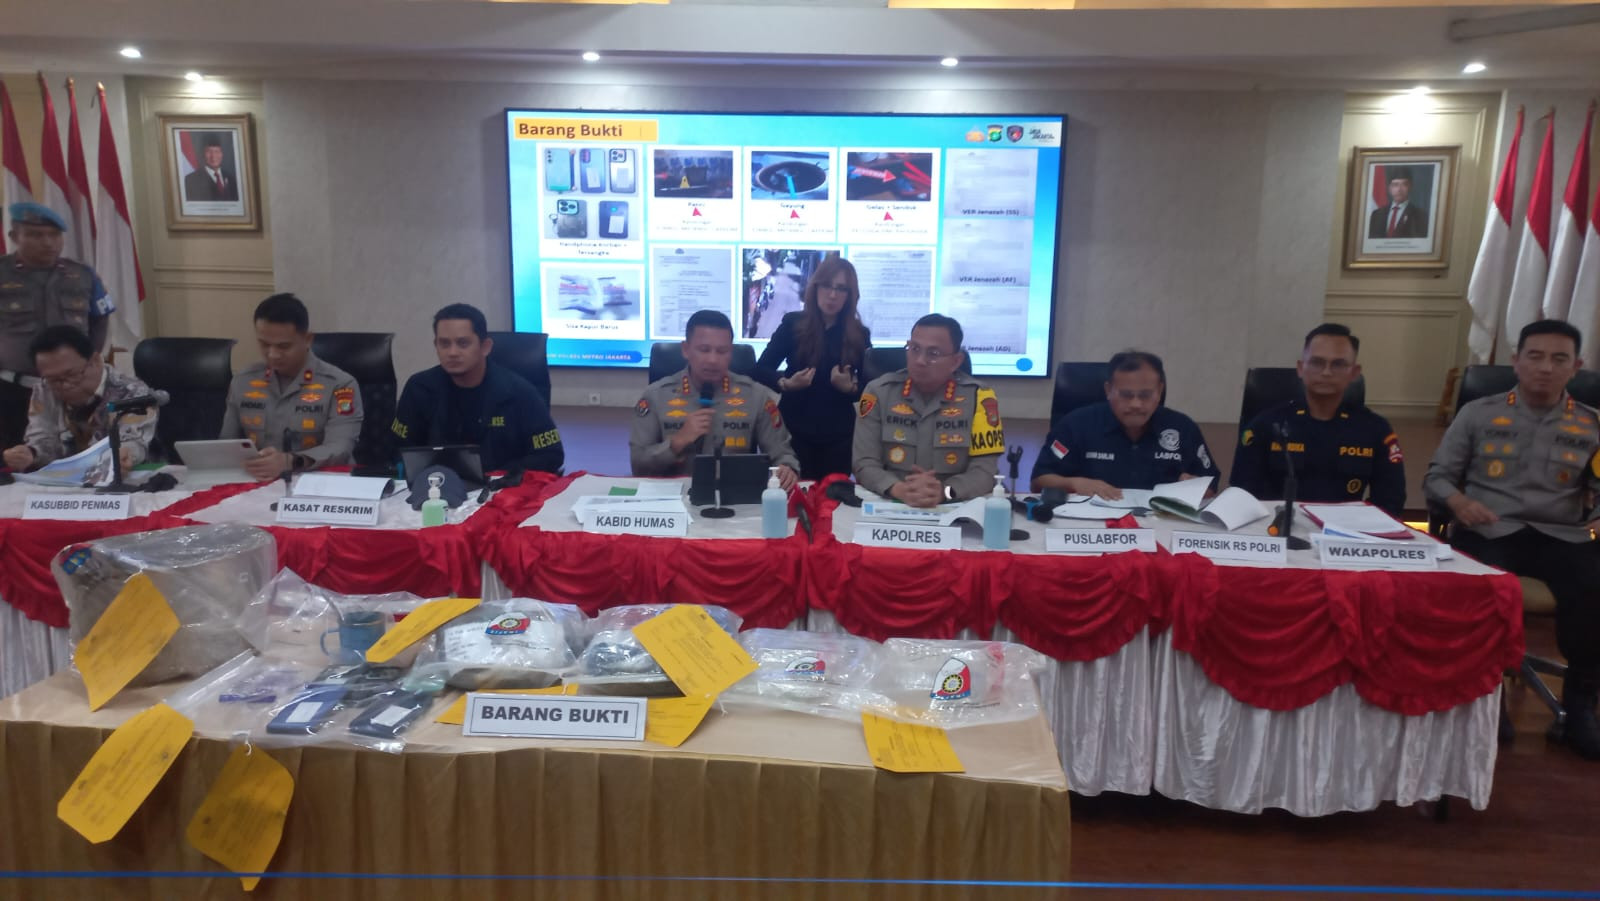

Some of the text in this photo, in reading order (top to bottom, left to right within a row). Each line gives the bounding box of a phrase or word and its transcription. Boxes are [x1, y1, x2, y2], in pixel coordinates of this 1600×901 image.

[518, 122, 623, 139] Barang Bukti
[295, 404, 323, 413] POLRI
[723, 422, 750, 430] POLRI
[886, 415, 918, 429] ERICK
[935, 420, 968, 430] POLRI
[1339, 446, 1373, 457] POLRI
[30, 500, 120, 510] KASUBBID PENMAS
[283, 503, 373, 515] KASAT RESKRIM
[596, 516, 675, 528] KABID HUMAS
[872, 529, 941, 544] KAPOLRES
[1064, 534, 1137, 544] PUSLABFOR
[1178, 538, 1281, 553] FORENSIK RS POLRI
[1329, 546, 1426, 560] WAKAPOLRES
[481, 705, 629, 723] BARANG BUKTI
